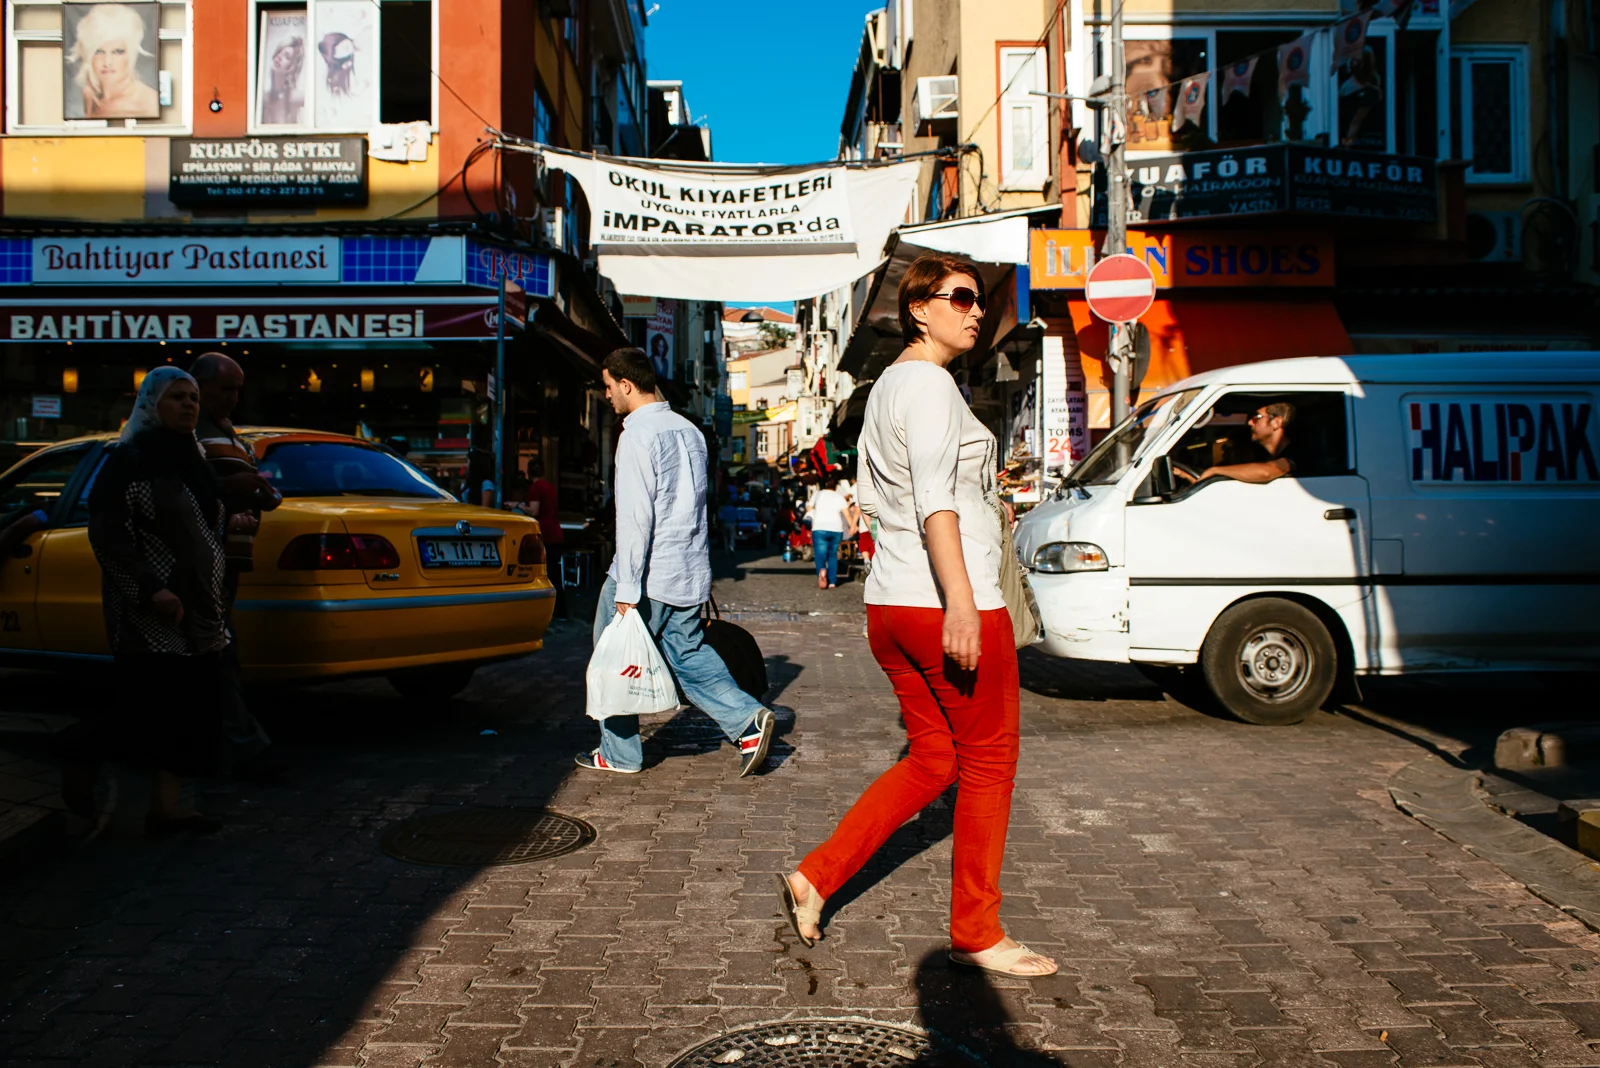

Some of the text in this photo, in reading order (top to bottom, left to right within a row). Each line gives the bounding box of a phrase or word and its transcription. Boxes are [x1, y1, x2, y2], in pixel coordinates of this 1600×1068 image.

[189, 139, 279, 159] KUAFÖR
[182, 161, 356, 173] EPİLASYON SİR AĞDA MAKYAJ
[1303, 155, 1424, 185] KUAFÖR
[179, 174, 359, 186] MANİKÜR PEDİKÜR KAŞ AĞDA
[608, 170, 833, 205] OKUL KIYAFETLERİ
[641, 199, 696, 217] UYGUN
[42, 242, 328, 278] Bahtiyar Pastanesi
[1185, 245, 1320, 277] SHOES
[10, 308, 424, 340] BAHTİYAR PASTANESİ
[1047, 427, 1083, 437] TOMS
[427, 541, 496, 561] 34 TAT 22
